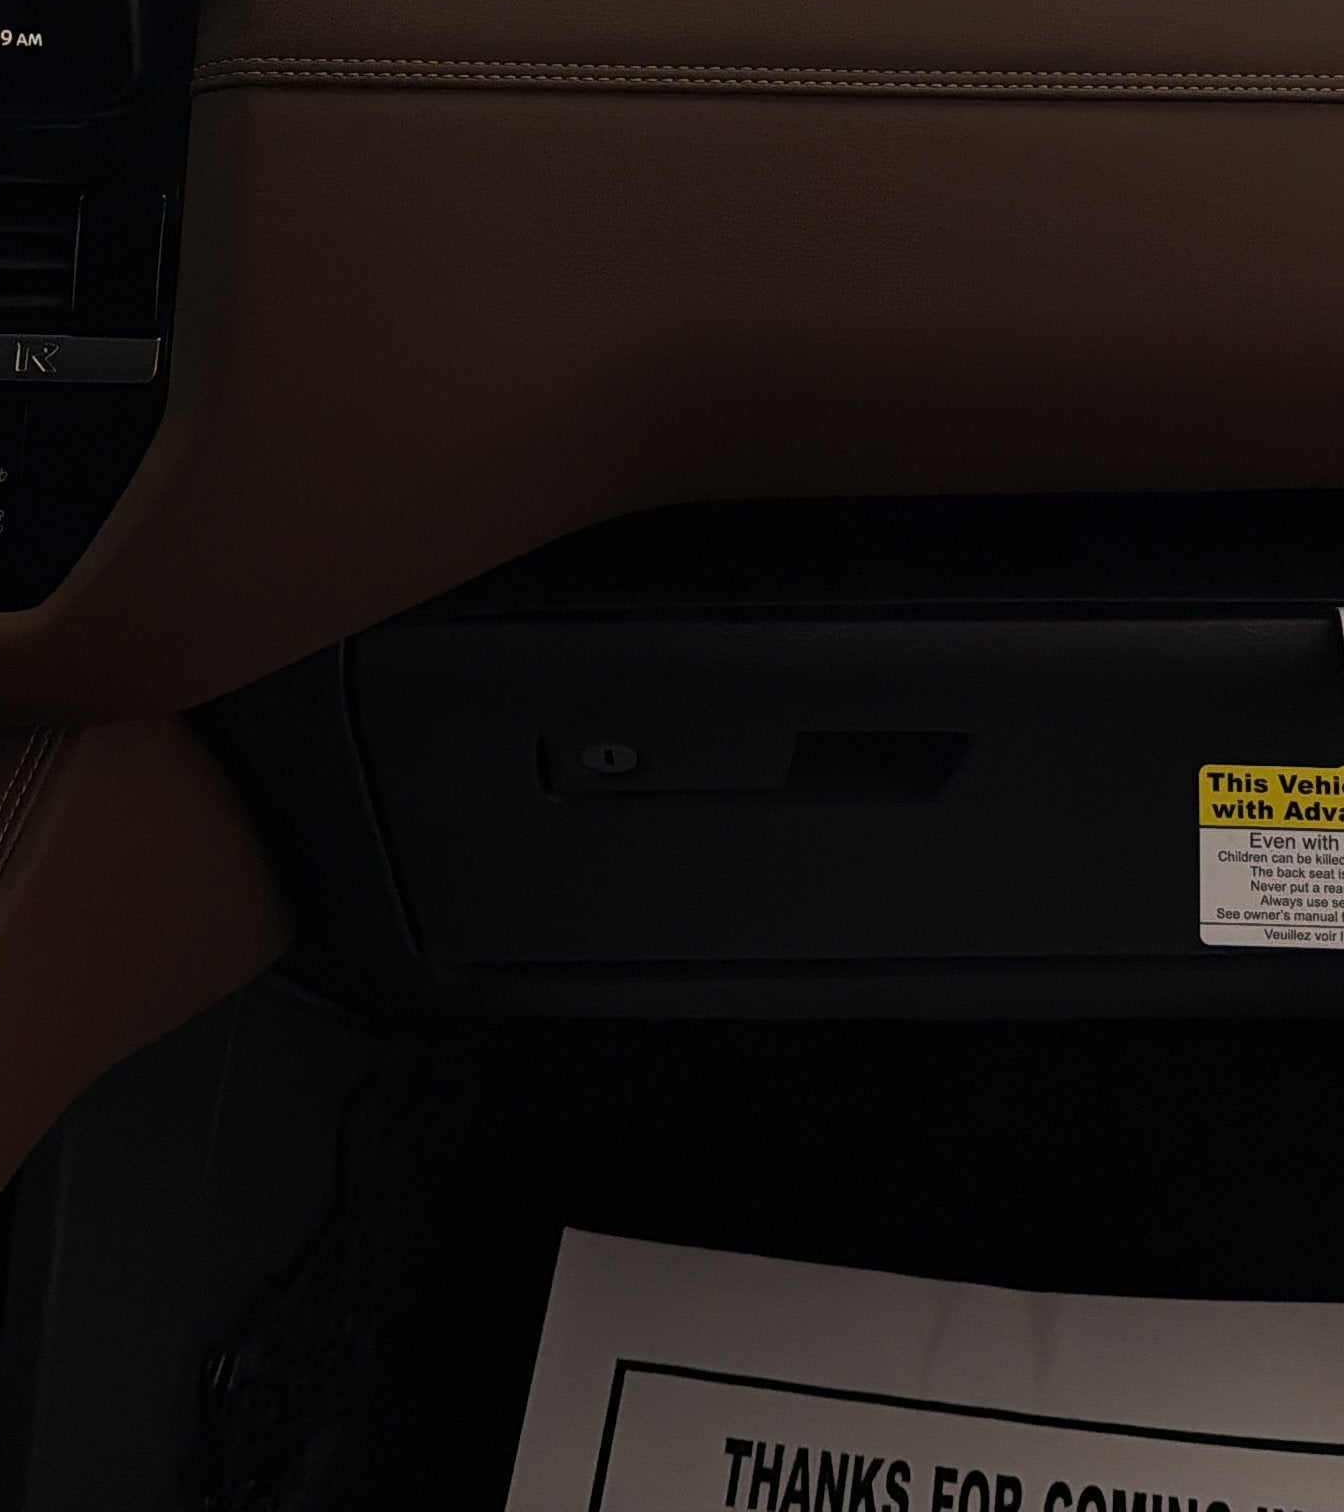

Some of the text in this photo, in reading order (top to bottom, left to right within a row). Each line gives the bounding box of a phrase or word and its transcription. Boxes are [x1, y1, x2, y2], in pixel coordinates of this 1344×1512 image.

[16, 32, 44, 47] AM
[1207, 772, 1268, 793] This
[1212, 799, 1273, 820] with
[1249, 832, 1296, 849] Even
[1302, 834, 1339, 850] with
[1218, 850, 1268, 863] Children
[1271, 854, 1294, 864] can
[1297, 853, 1312, 864] be
[1250, 866, 1273, 878] The
[1277, 867, 1306, 878] back
[1309, 868, 1336, 879] seat
[1250, 880, 1287, 892] Never
[1290, 881, 1309, 895] put
[1313, 884, 1320, 893] a
[1260, 895, 1304, 909] Always
[1307, 898, 1328, 908] use
[1216, 908, 1241, 920] See
[1244, 909, 1291, 921] owner's
[1294, 911, 1338, 922] manual
[1264, 929, 1310, 941] Veuillez
[1314, 929, 1337, 941] voir
[724, 1438, 911, 1512] THANKS
